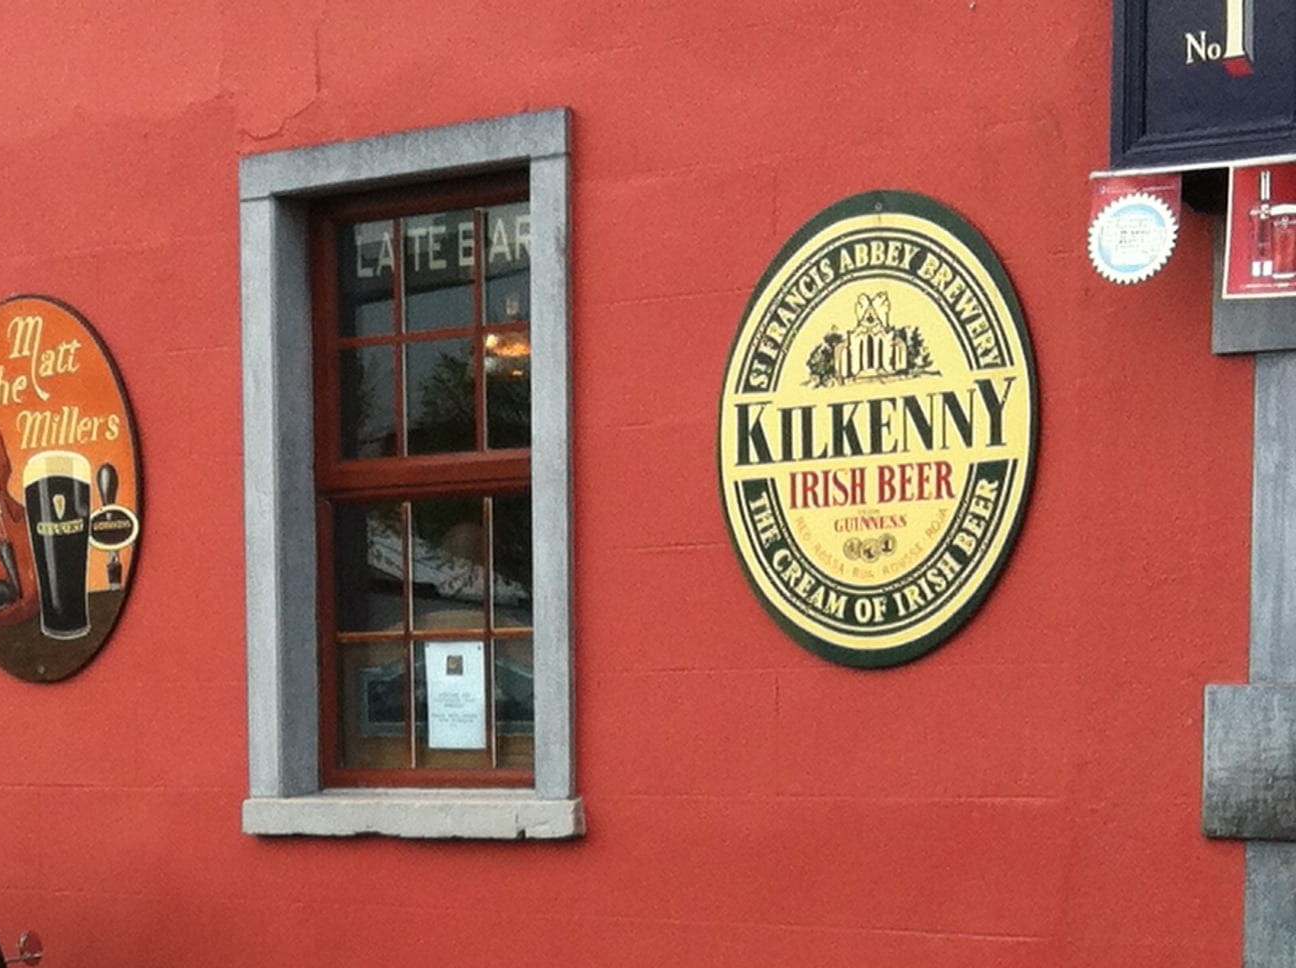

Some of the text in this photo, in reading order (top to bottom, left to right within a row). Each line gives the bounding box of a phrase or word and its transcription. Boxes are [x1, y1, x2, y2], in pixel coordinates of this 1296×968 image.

[355, 224, 447, 279] LATE
[758, 257, 834, 360] FRANCIS
[839, 240, 921, 273] ABBEY
[917, 251, 1002, 370] BREWERY
[7, 315, 82, 401] Matt
[16, 406, 121, 450] Millers
[733, 377, 1016, 466] KILKENNY
[788, 460, 955, 511] IRISH BEER
[750, 478, 999, 623] THE CREAM OF IRISH BEER
[834, 514, 908, 534] GUINNESS
